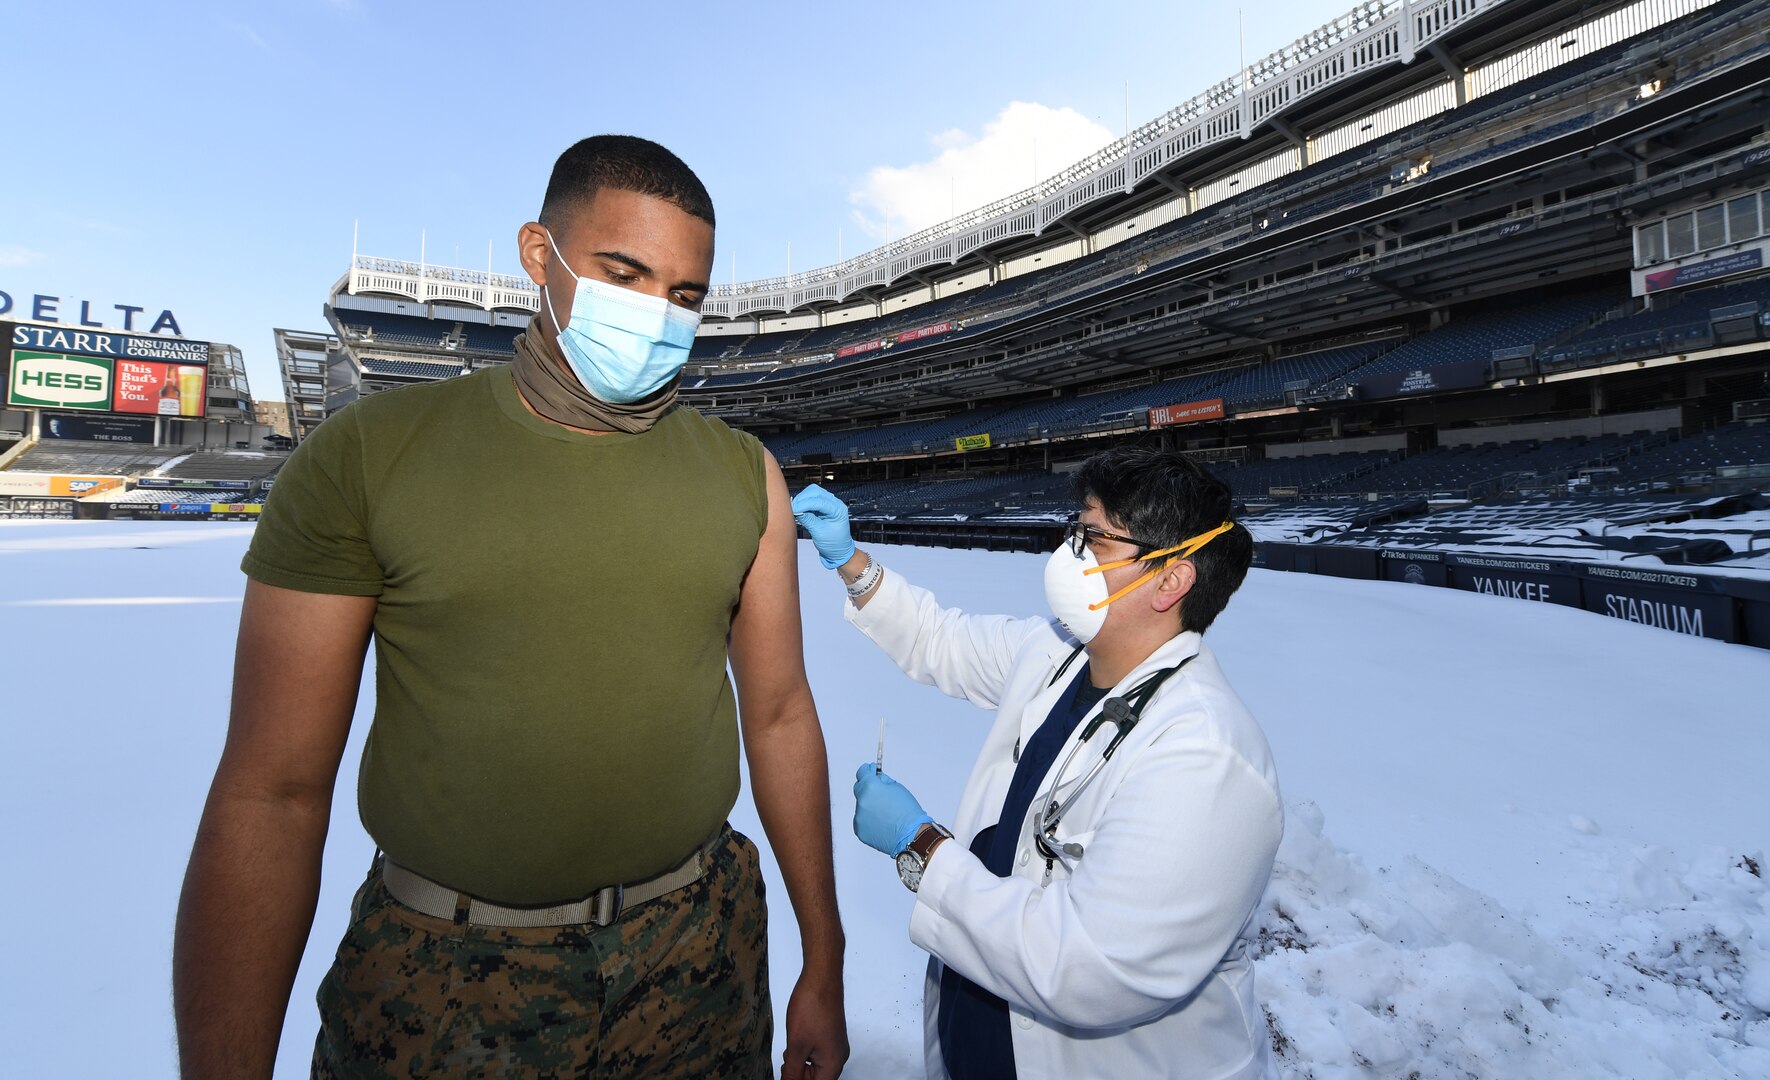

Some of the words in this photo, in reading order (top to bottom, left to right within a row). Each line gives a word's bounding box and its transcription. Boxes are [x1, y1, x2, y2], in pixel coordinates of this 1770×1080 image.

[1500, 224, 1520, 235] 1949
[1682, 265, 1711, 275] OFFICIAL
[1713, 257, 1740, 268] AIRLINE
[1707, 266, 1726, 275] YORK
[1727, 259, 1759, 271] YANKEES
[917, 327, 933, 338] PARTY
[934, 323, 948, 334] DECK
[12, 326, 116, 354] STARR
[128, 338, 209, 353] INSURANCE
[854, 342, 867, 353] PARTY
[868, 340, 879, 350] DECK
[127, 347, 208, 361] COMPANIES
[121, 363, 152, 374] This
[22, 370, 102, 391] HESS
[121, 372, 157, 383] Bud's
[121, 381, 144, 391] For
[120, 391, 149, 401] You.
[1153, 408, 1173, 424] JBL
[69, 481, 94, 492] SAP
[1456, 556, 1550, 571] YANKEES.COM/2021TICKETS
[1588, 567, 1698, 587] YANKEES.COM/2021TICKETS
[1472, 576, 1550, 602] YANKEE
[1605, 593, 1704, 637] STADIUM
